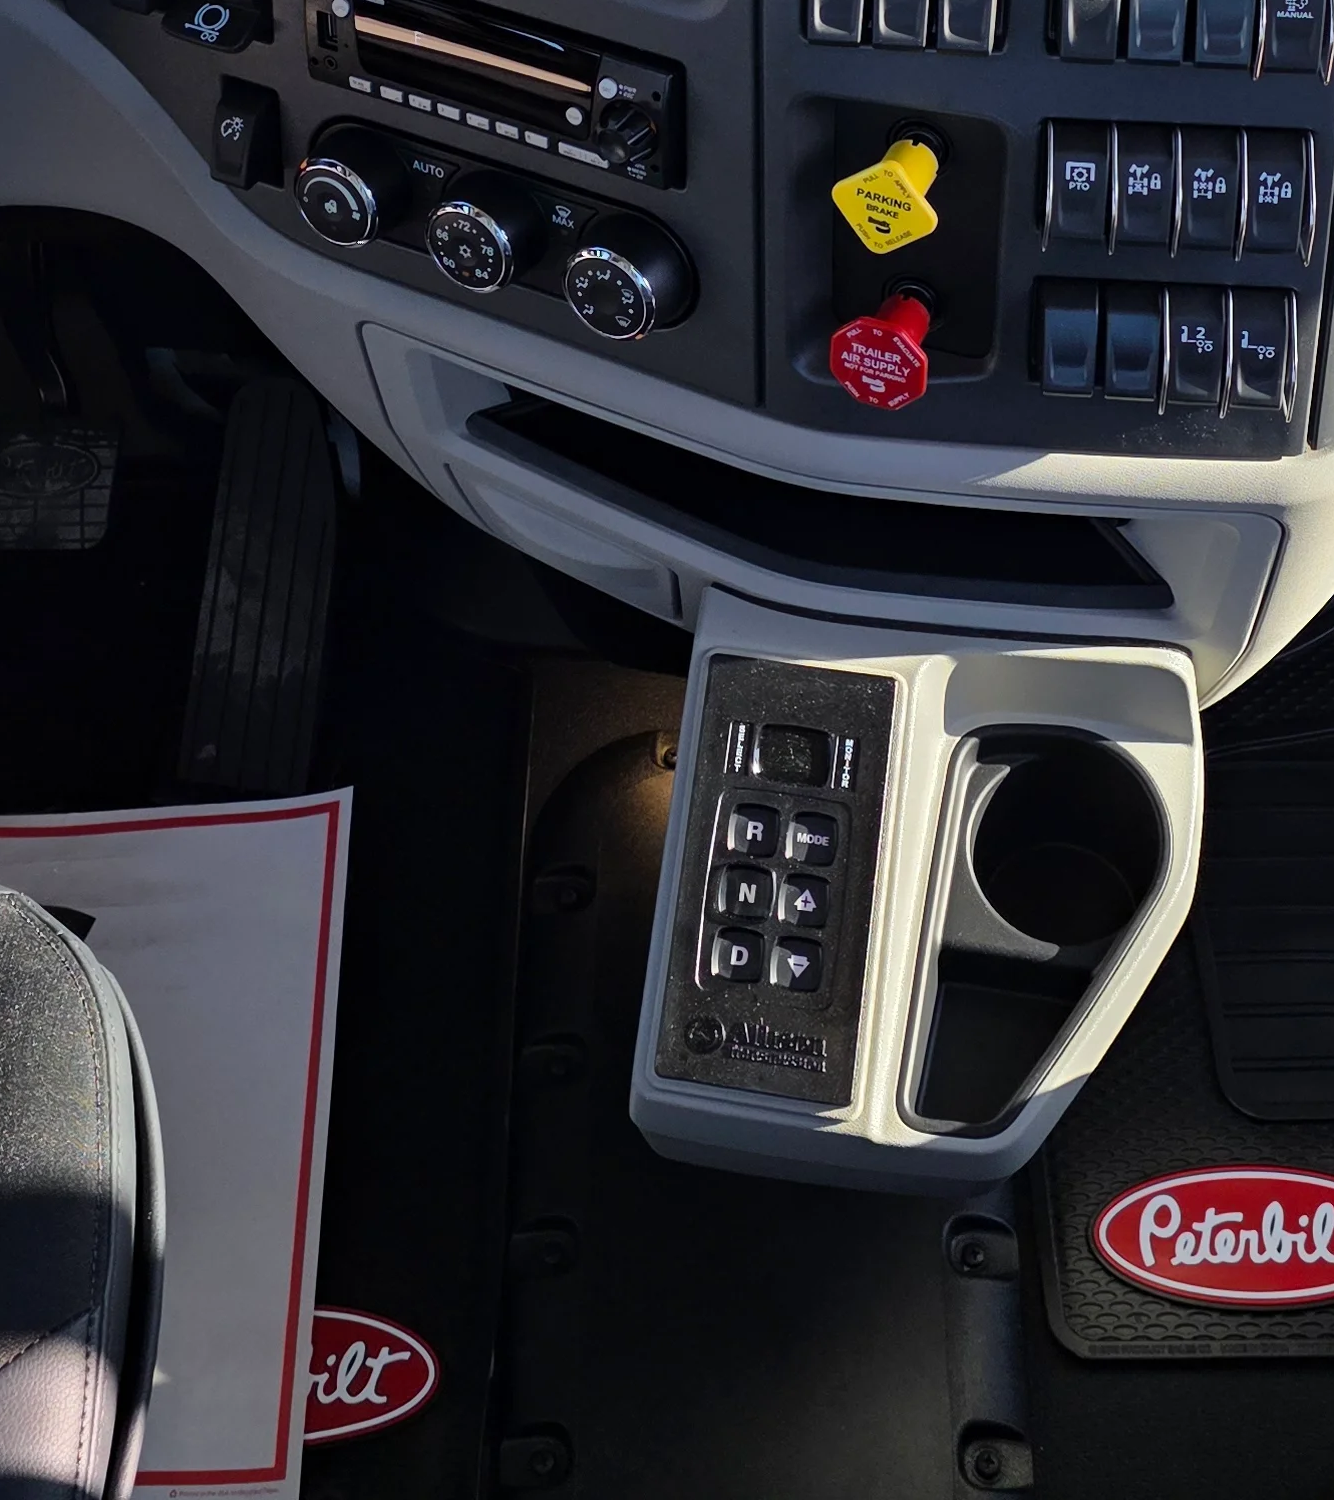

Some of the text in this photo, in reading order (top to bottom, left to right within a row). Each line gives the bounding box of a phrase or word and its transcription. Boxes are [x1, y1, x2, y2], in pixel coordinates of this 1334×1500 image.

[1276, 10, 1315, 19] MANUAL
[412, 159, 445, 179] AUTO
[883, 169, 894, 178] TO
[1068, 181, 1091, 192] PTO
[856, 187, 912, 212] PARKING
[865, 203, 900, 220] BRAKE
[457, 219, 471, 233] 72
[551, 213, 575, 230] MAX
[435, 228, 449, 242] 66
[480, 244, 494, 257] 78
[442, 256, 456, 269] 60
[474, 268, 489, 281] 84
[851, 342, 902, 365] TRAILER
[892, 336, 922, 368] EVACUATE
[841, 351, 911, 377] AIR SUPPLY
[844, 361, 859, 371] NOT
[859, 365, 875, 376] FOR
[875, 370, 907, 384] PARKING
[734, 724, 746, 773] SELECT
[841, 738, 855, 789] MONITOR
[746, 820, 764, 841] R
[796, 832, 830, 847] MODE
[738, 882, 757, 904] N
[730, 945, 749, 966] D
